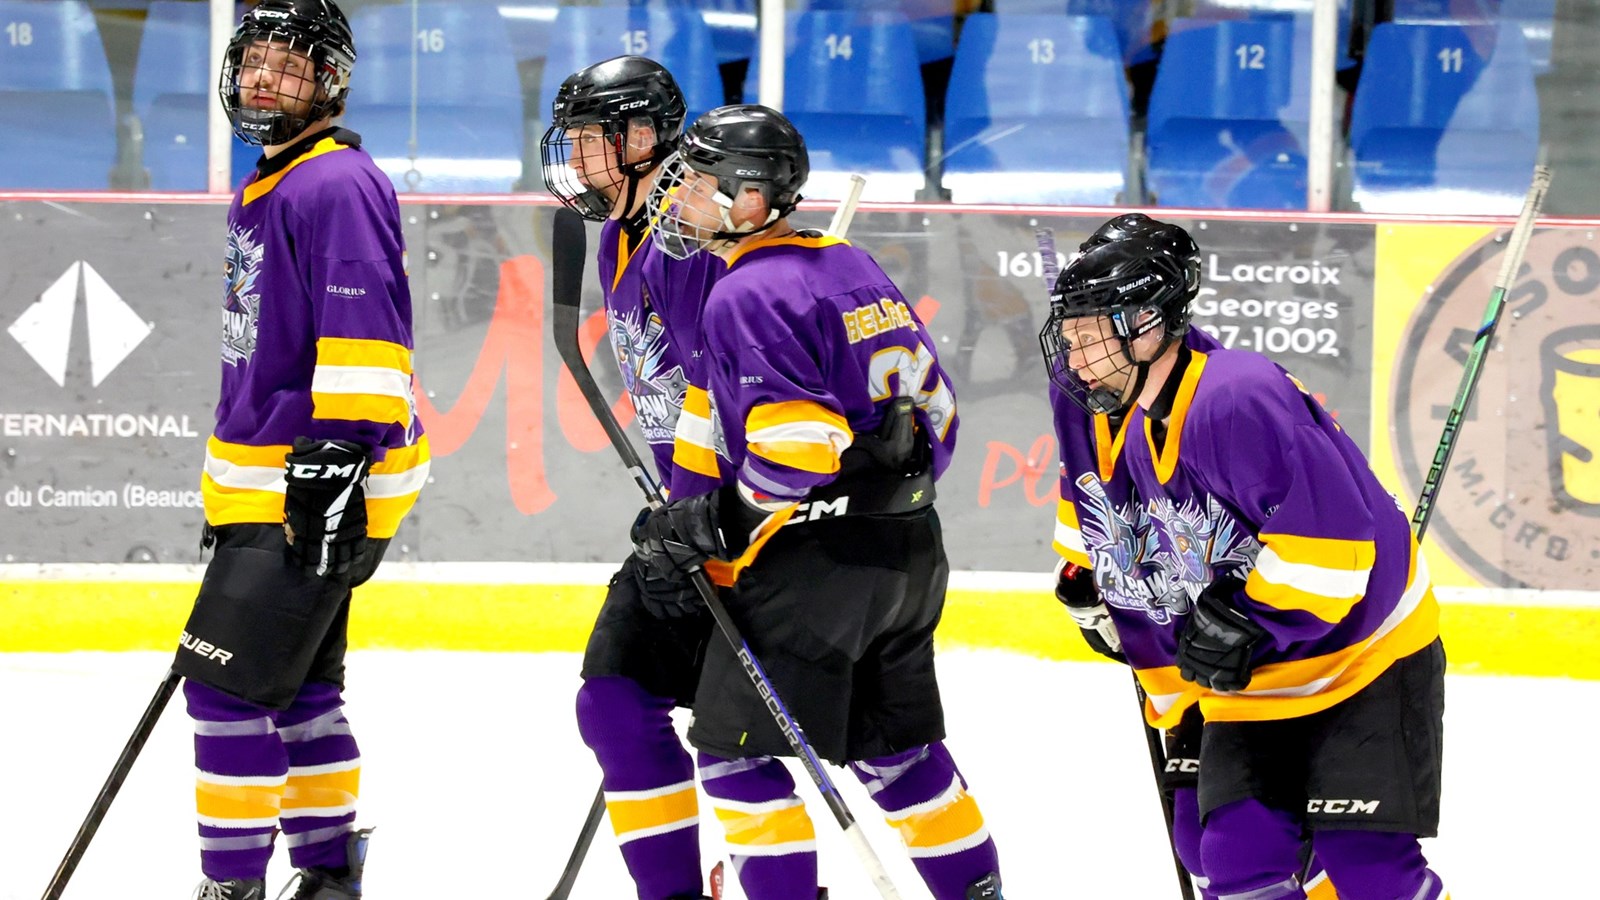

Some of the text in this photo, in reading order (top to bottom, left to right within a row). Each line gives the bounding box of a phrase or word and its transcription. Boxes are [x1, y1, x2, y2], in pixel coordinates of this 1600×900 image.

[254, 10, 289, 20] CCM
[6, 23, 33, 46] 18
[418, 29, 444, 52] 16
[621, 30, 648, 54] 15
[825, 34, 852, 60] 14
[1028, 38, 1055, 64] 13
[1236, 44, 1265, 69] 12
[1438, 48, 1462, 73] 11
[619, 99, 650, 111] CCM
[241, 121, 271, 131] CCM
[1208, 253, 1340, 285] Lacroix
[326, 284, 366, 296] GLORIUS
[0, 413, 199, 437] ERNATIONAL
[285, 462, 356, 479] CM
[5, 485, 33, 507] du
[37, 484, 118, 507] Camion
[784, 495, 849, 525] CM
[737, 647, 800, 746] RIBCOR
[1163, 758, 1200, 773] CC
[1306, 799, 1380, 814] CCM
